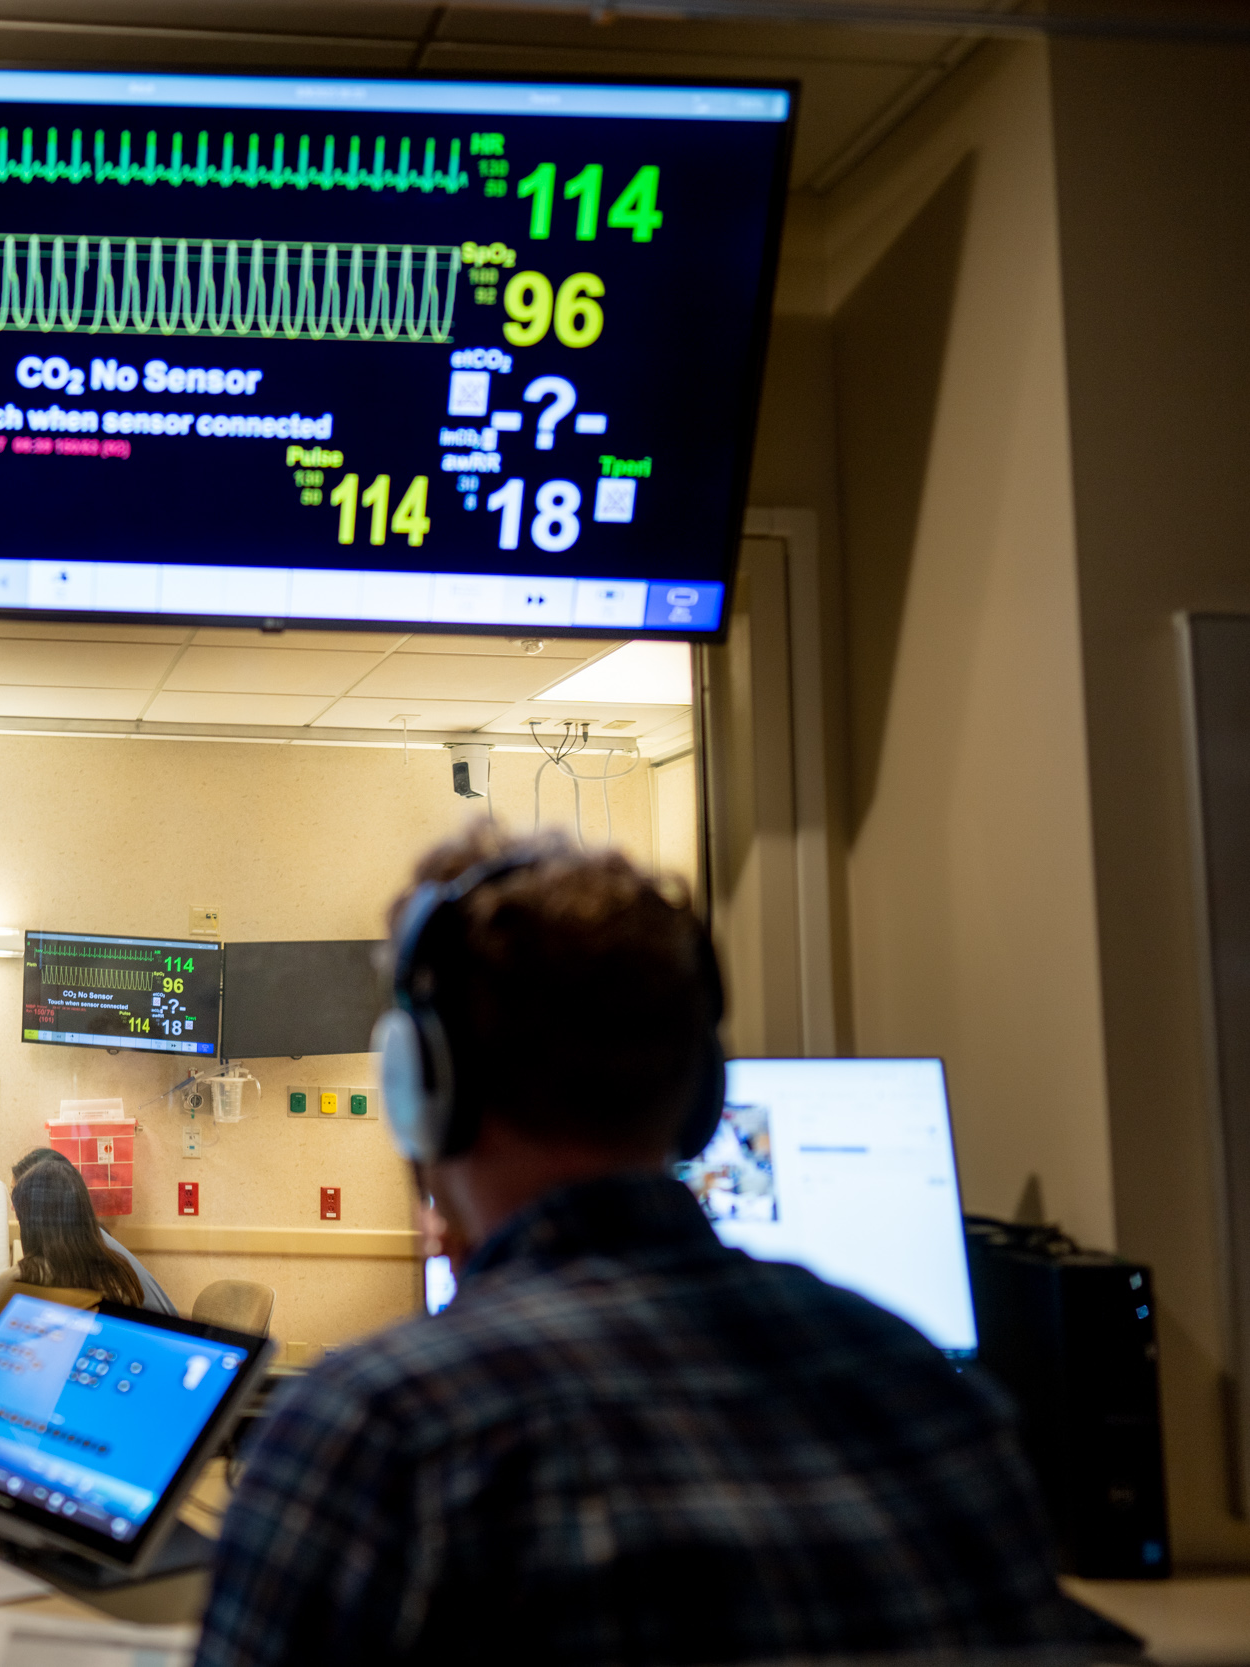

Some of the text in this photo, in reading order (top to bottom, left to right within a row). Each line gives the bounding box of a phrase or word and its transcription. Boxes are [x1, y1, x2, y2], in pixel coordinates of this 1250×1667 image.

[470, 132, 505, 156] HR
[517, 162, 664, 243] 114
[502, 270, 606, 349] 96
[90, 357, 139, 392] No
[143, 358, 264, 395] Sensor
[26, 405, 100, 434] when
[102, 411, 194, 436] sensor
[195, 412, 334, 441] connected
[286, 445, 344, 468] Pulse
[330, 473, 431, 547] 114
[487, 476, 583, 553] 18
[164, 956, 195, 973] 114
[77, 991, 88, 999] No
[89, 991, 114, 1000] Sensor
[162, 977, 184, 994] 96
[34, 1008, 55, 1016] 150/76
[47, 998, 64, 1006] Touch
[129, 1017, 151, 1034] 114
[161, 1019, 183, 1036] 18
